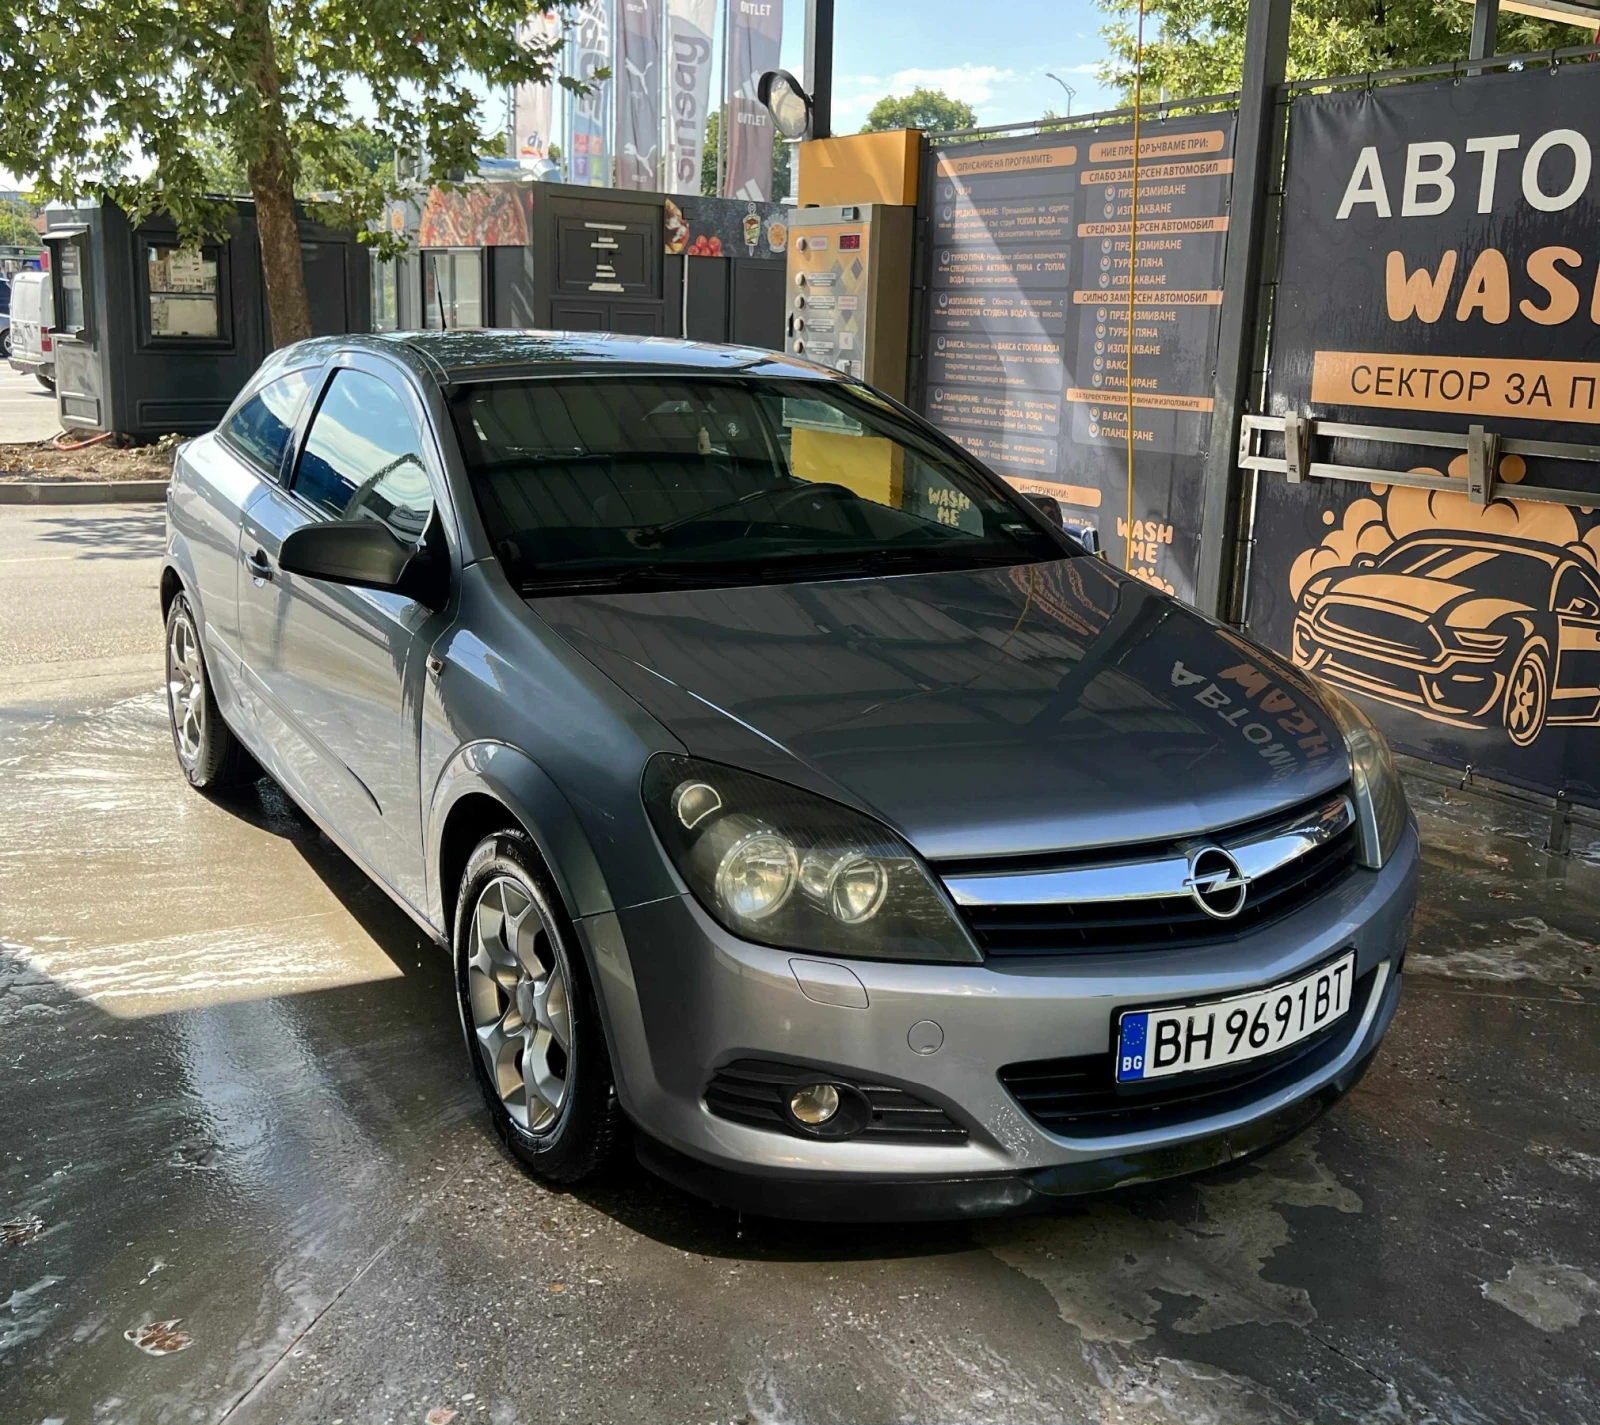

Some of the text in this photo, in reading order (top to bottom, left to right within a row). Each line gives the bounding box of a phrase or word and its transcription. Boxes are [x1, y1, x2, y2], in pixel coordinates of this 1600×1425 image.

[740, 3, 772, 17] OUTLET
[674, 33, 712, 185] sinsay
[737, 111, 767, 127] OUTLET
[1100, 138, 1209, 157] НИЕ ПРЕОРЪЧВАМЕ ПРИ:
[957, 154, 1052, 171] ОПИСАНИЕ НА ПРОГРАМИТЕ:
[1089, 171, 1116, 182] СЛАБО
[1163, 162, 1219, 176] АВТОМОБИЛ
[1335, 128, 1593, 220] АВТО
[1117, 184, 1186, 200] ПРЕИЗМИВАНЕ
[1116, 203, 1172, 216] ИЗПАКВАНЕ
[1086, 224, 1116, 236] СРЕДНО
[1161, 219, 1214, 231] АВТОМОБИЛ
[1114, 239, 1182, 253] ПРЕИЗМИВАНЕ
[1140, 257, 1164, 268] ПЯНА
[1112, 274, 1166, 285] ИЗПАКВАНЕ
[1082, 293, 1109, 302] СИЛНО
[1154, 293, 1208, 303] АВТОМОБИЛ
[1109, 310, 1177, 322] ПРЕДЗМИВАНЕ
[1108, 327, 1159, 338] ТУРБ ПЯНА
[1107, 343, 1161, 355] ИЗПЛКВАНЕ
[1351, 365, 1490, 402] СЕКТОР
[1504, 372, 1552, 407] ЗА
[1102, 411, 1128, 422] ВАКСА
[1101, 427, 1154, 441] ГЛАНЦРАНЕ
[1019, 483, 1070, 500] ИНСТРУКЦИИ:
[1116, 516, 1174, 544] WASH
[1130, 541, 1158, 564] ME
[1121, 1055, 1143, 1072] BG
